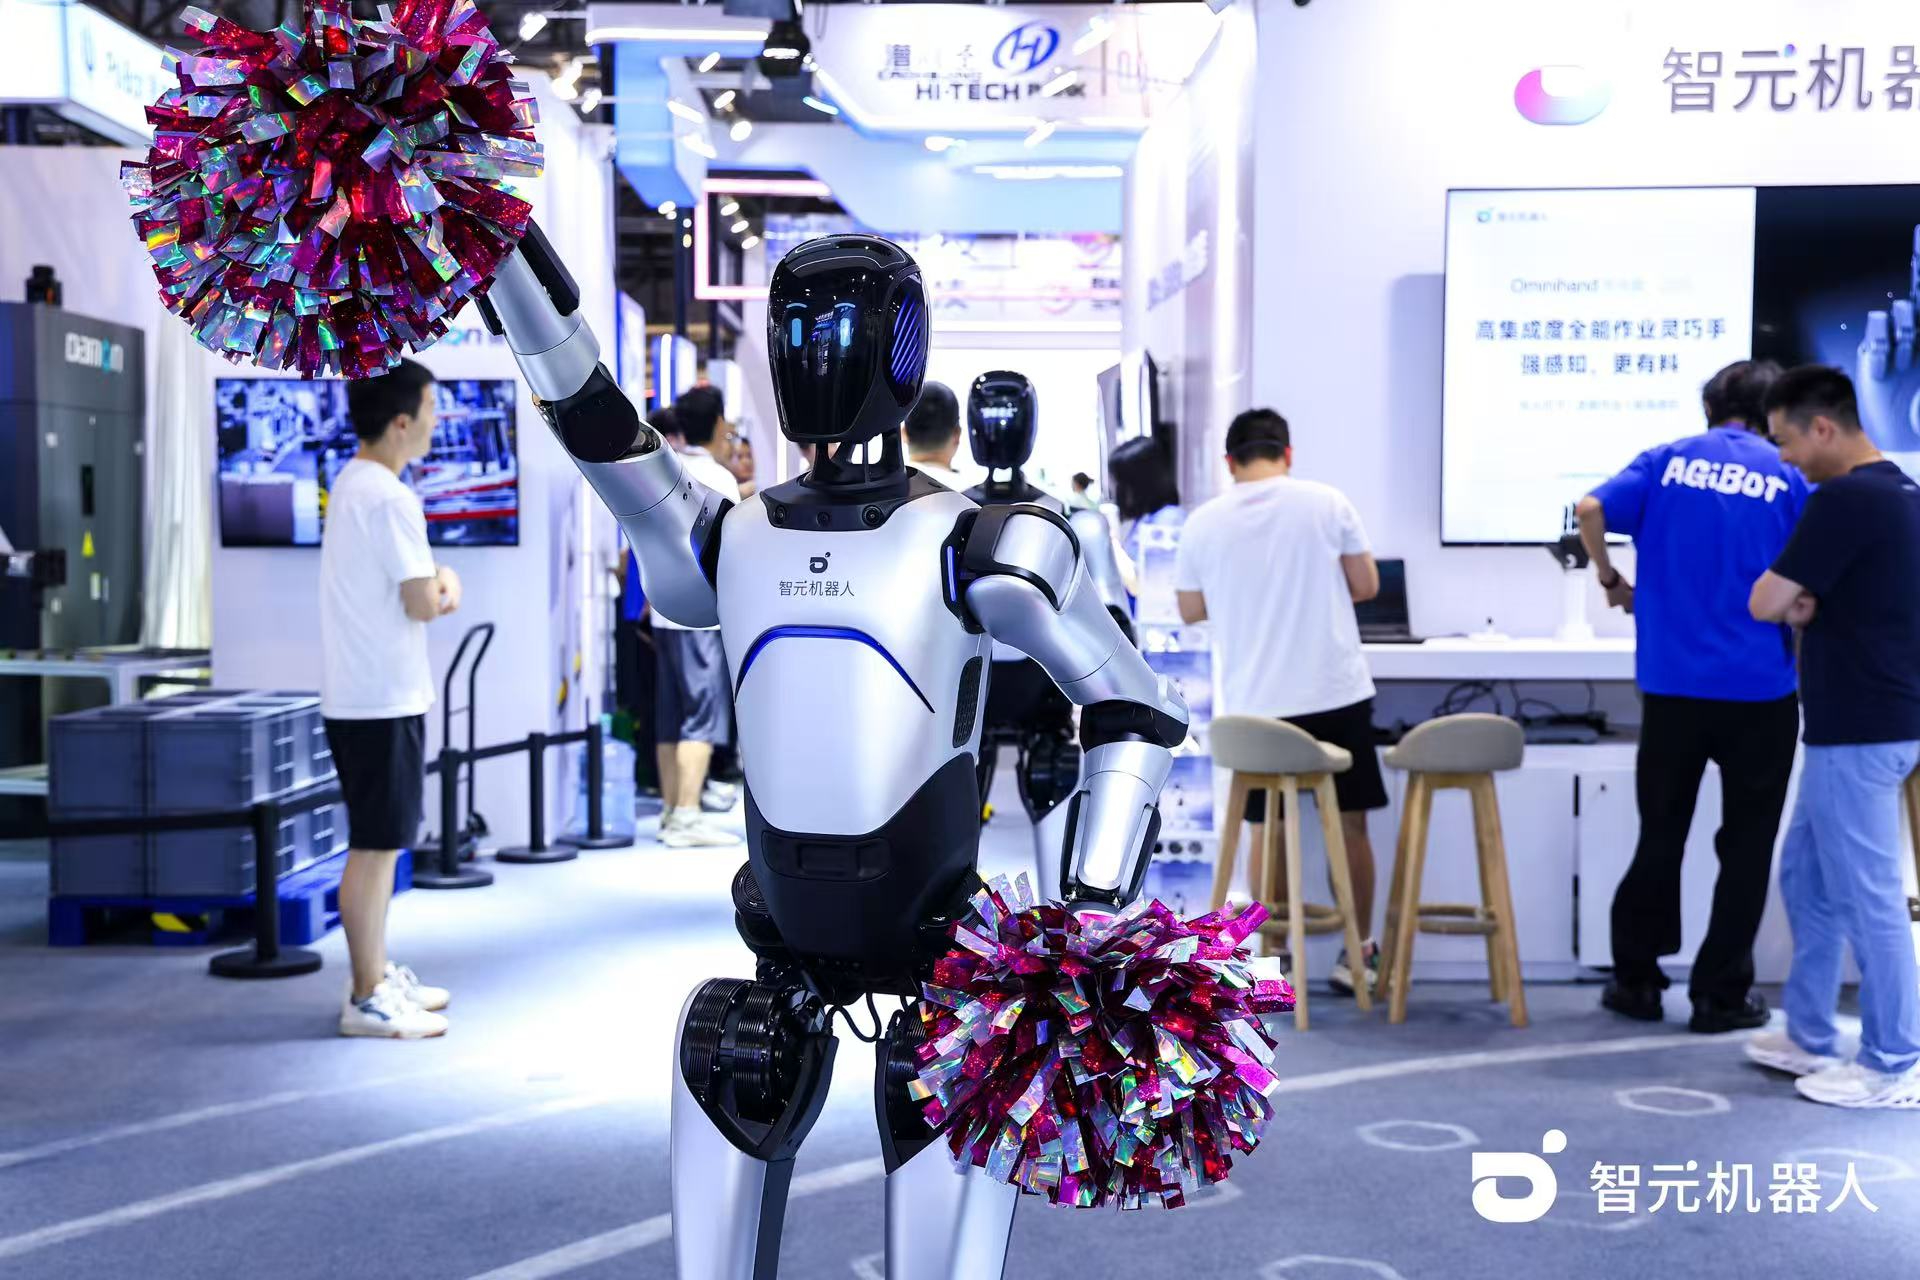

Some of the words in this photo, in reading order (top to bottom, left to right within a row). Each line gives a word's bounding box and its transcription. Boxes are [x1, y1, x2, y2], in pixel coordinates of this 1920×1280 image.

[778, 580, 855, 597] 智元机器人
